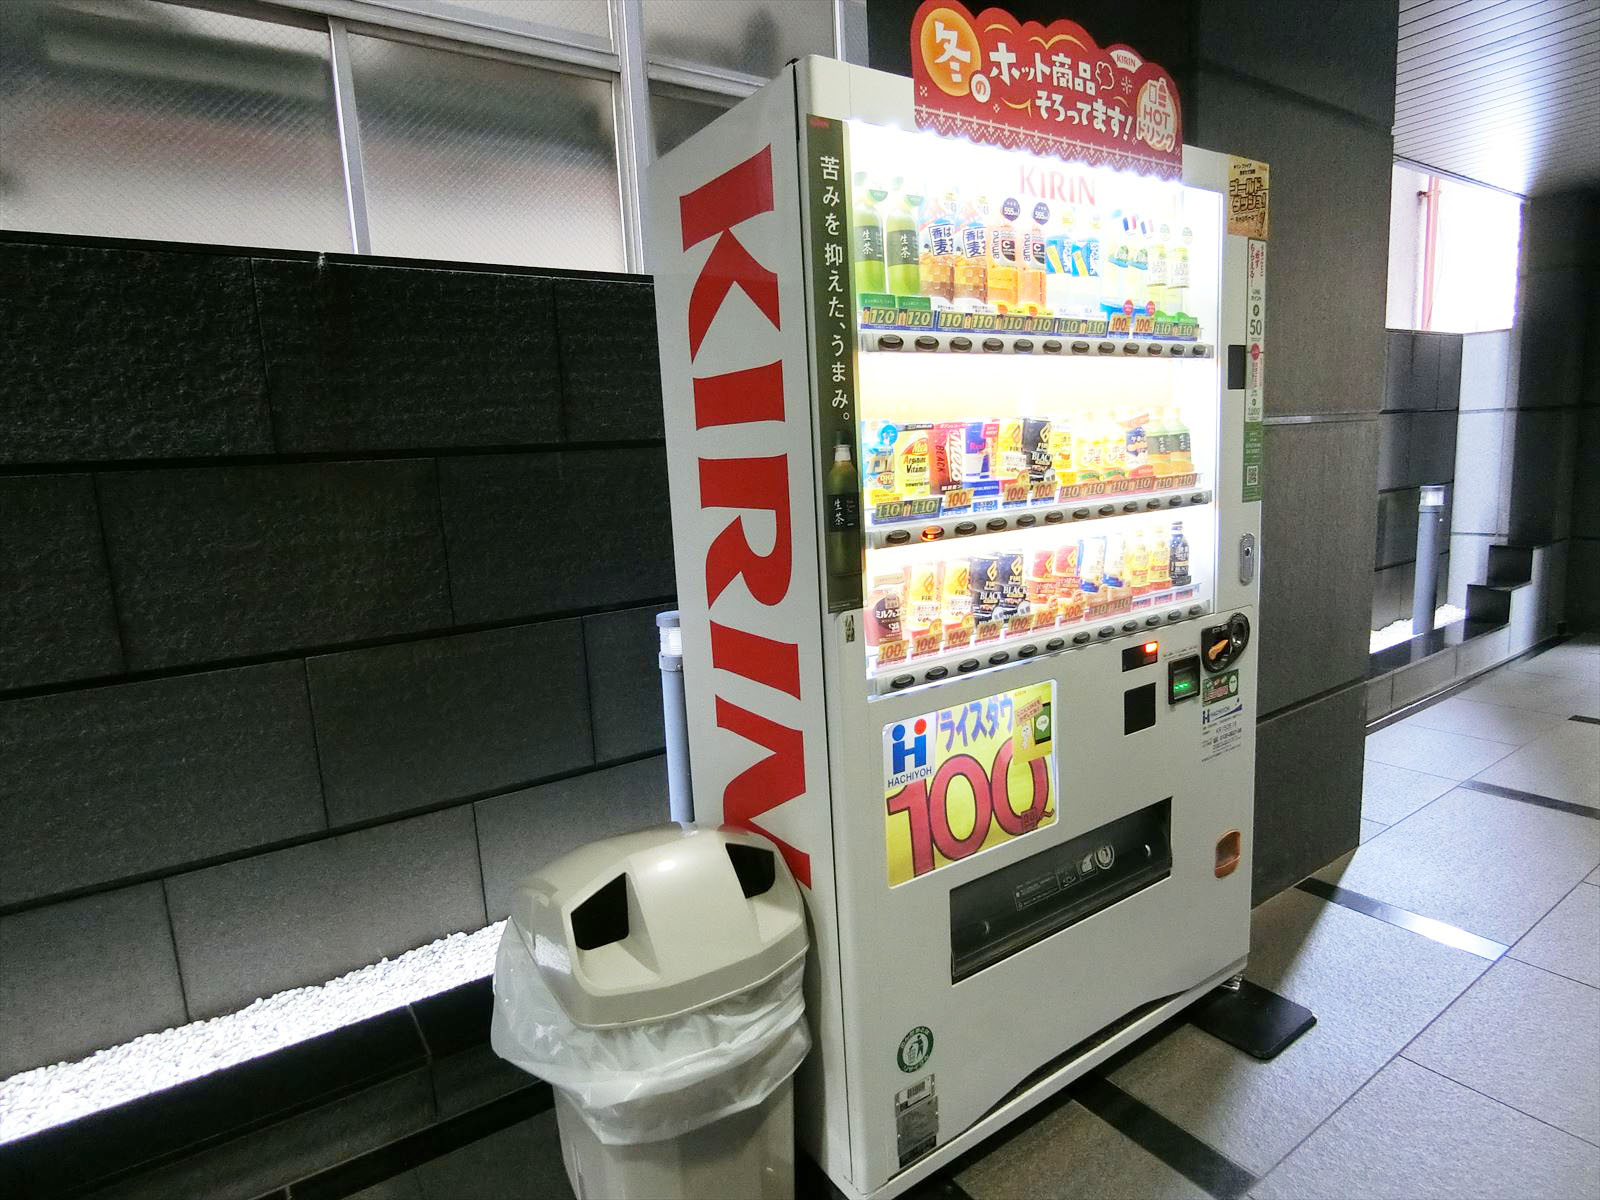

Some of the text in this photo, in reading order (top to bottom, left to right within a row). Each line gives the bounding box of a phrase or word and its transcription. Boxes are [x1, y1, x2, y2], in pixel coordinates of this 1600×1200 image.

[1116, 54, 1137, 67] KIRIN
[1143, 104, 1171, 128] HOT
[1020, 164, 1096, 207] KIRIN
[871, 310, 895, 325] 120
[908, 312, 931, 325] 120
[940, 313, 962, 326] 110
[973, 315, 993, 328] 110
[1003, 317, 1023, 329] 110
[1112, 317, 1126, 331] 100
[1033, 318, 1051, 331] 110
[1061, 320, 1078, 332] 110
[1088, 321, 1105, 334] 110
[1136, 319, 1150, 332] 100
[1156, 324, 1171, 336] 110
[1179, 326, 1193, 337] 110
[1136, 477, 1151, 488] 110
[1158, 475, 1172, 487] 110
[1179, 473, 1192, 485] 110
[1035, 483, 1052, 498] 100
[1063, 485, 1079, 498] 110
[1088, 483, 1104, 495] 110
[1112, 480, 1128, 492] 110
[949, 491, 968, 506] 100
[1007, 487, 1024, 501] 100
[878, 503, 900, 517] 110
[913, 500, 935, 514] 110
[680, 143, 811, 891] KIRIN
[980, 591, 1001, 600] BLACK
[1003, 586, 1027, 594] BLACK
[1037, 611, 1053, 623] 100
[1065, 606, 1081, 618] 100
[980, 623, 997, 637] 100
[1010, 617, 1028, 631] 100
[948, 630, 967, 645] 100
[917, 637, 936, 652] 100
[881, 643, 899, 660] 100
[935, 695, 1014, 752] ライスダウ
[888, 765, 932, 788] HACHIYOH
[886, 736, 1050, 878] 100
